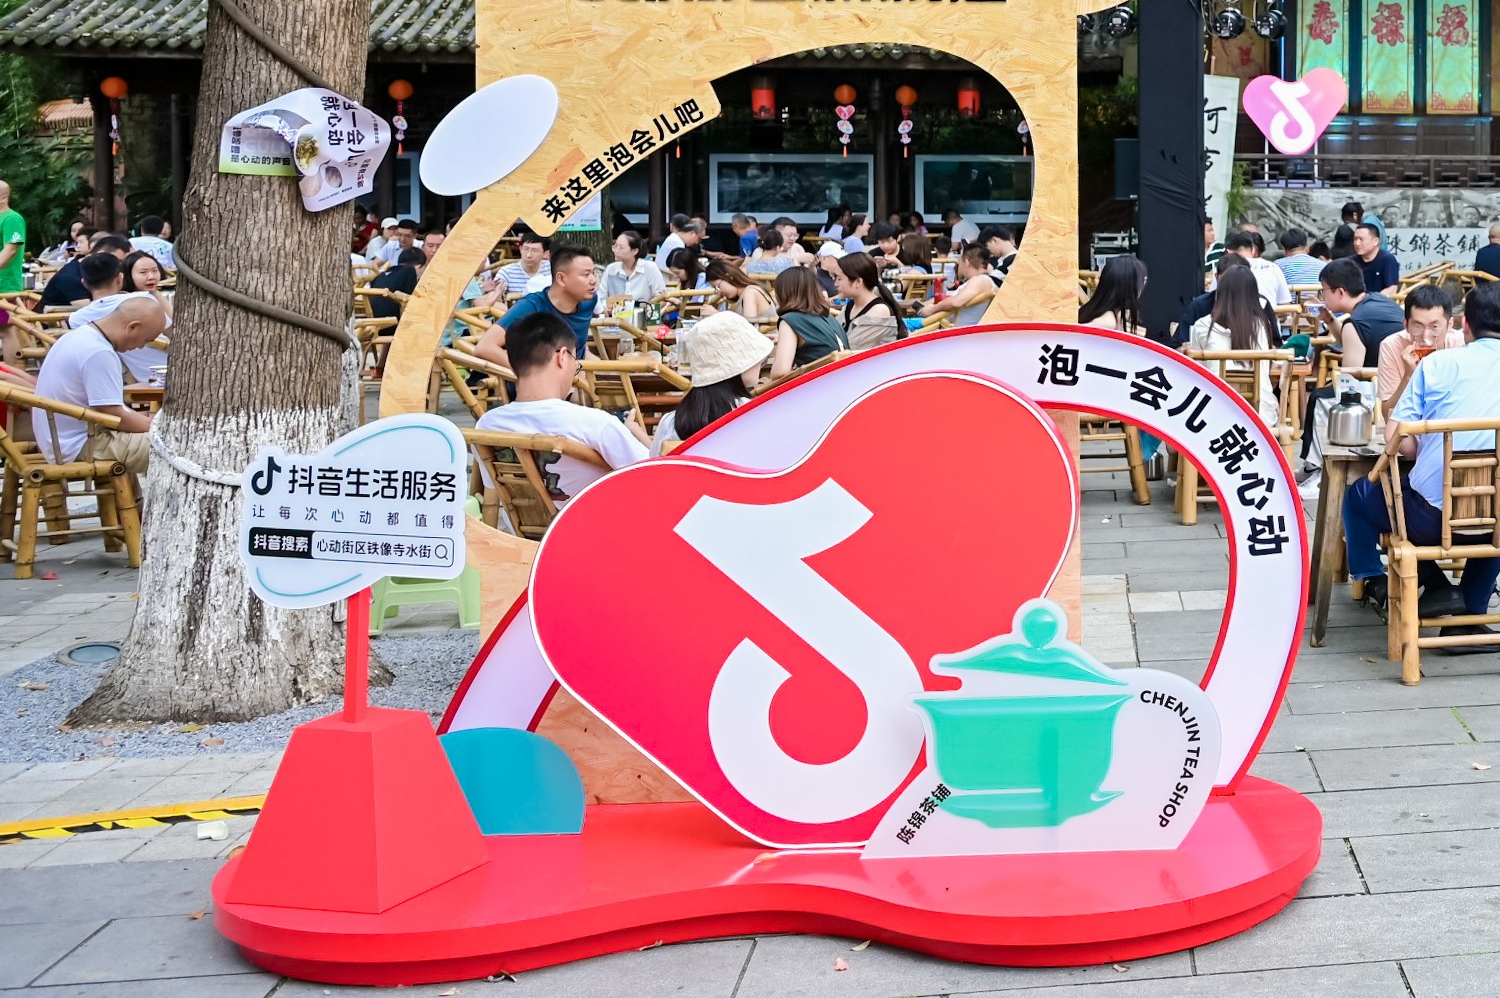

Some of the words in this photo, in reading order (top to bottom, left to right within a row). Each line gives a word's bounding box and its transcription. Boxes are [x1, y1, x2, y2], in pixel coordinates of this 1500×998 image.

[320, 96, 345, 146] 就心动
[231, 154, 291, 166] 是心动的声音
[541, 98, 704, 224] 来这里泡会儿吧
[1037, 343, 1212, 434] 泡一会儿
[1208, 423, 1289, 557] 就心动
[288, 464, 457, 503] 抖音生活服务
[252, 504, 455, 530] 让每次心动都值得
[253, 533, 309, 553] 抖音搜索
[316, 539, 431, 559] 心动街区铁像寺水街
[1140, 690, 1201, 742] CHENJIN
[1180, 746, 1201, 779] TEA
[896, 783, 952, 845] 陈锦茶铺
[1158, 782, 1189, 828] SHOP
